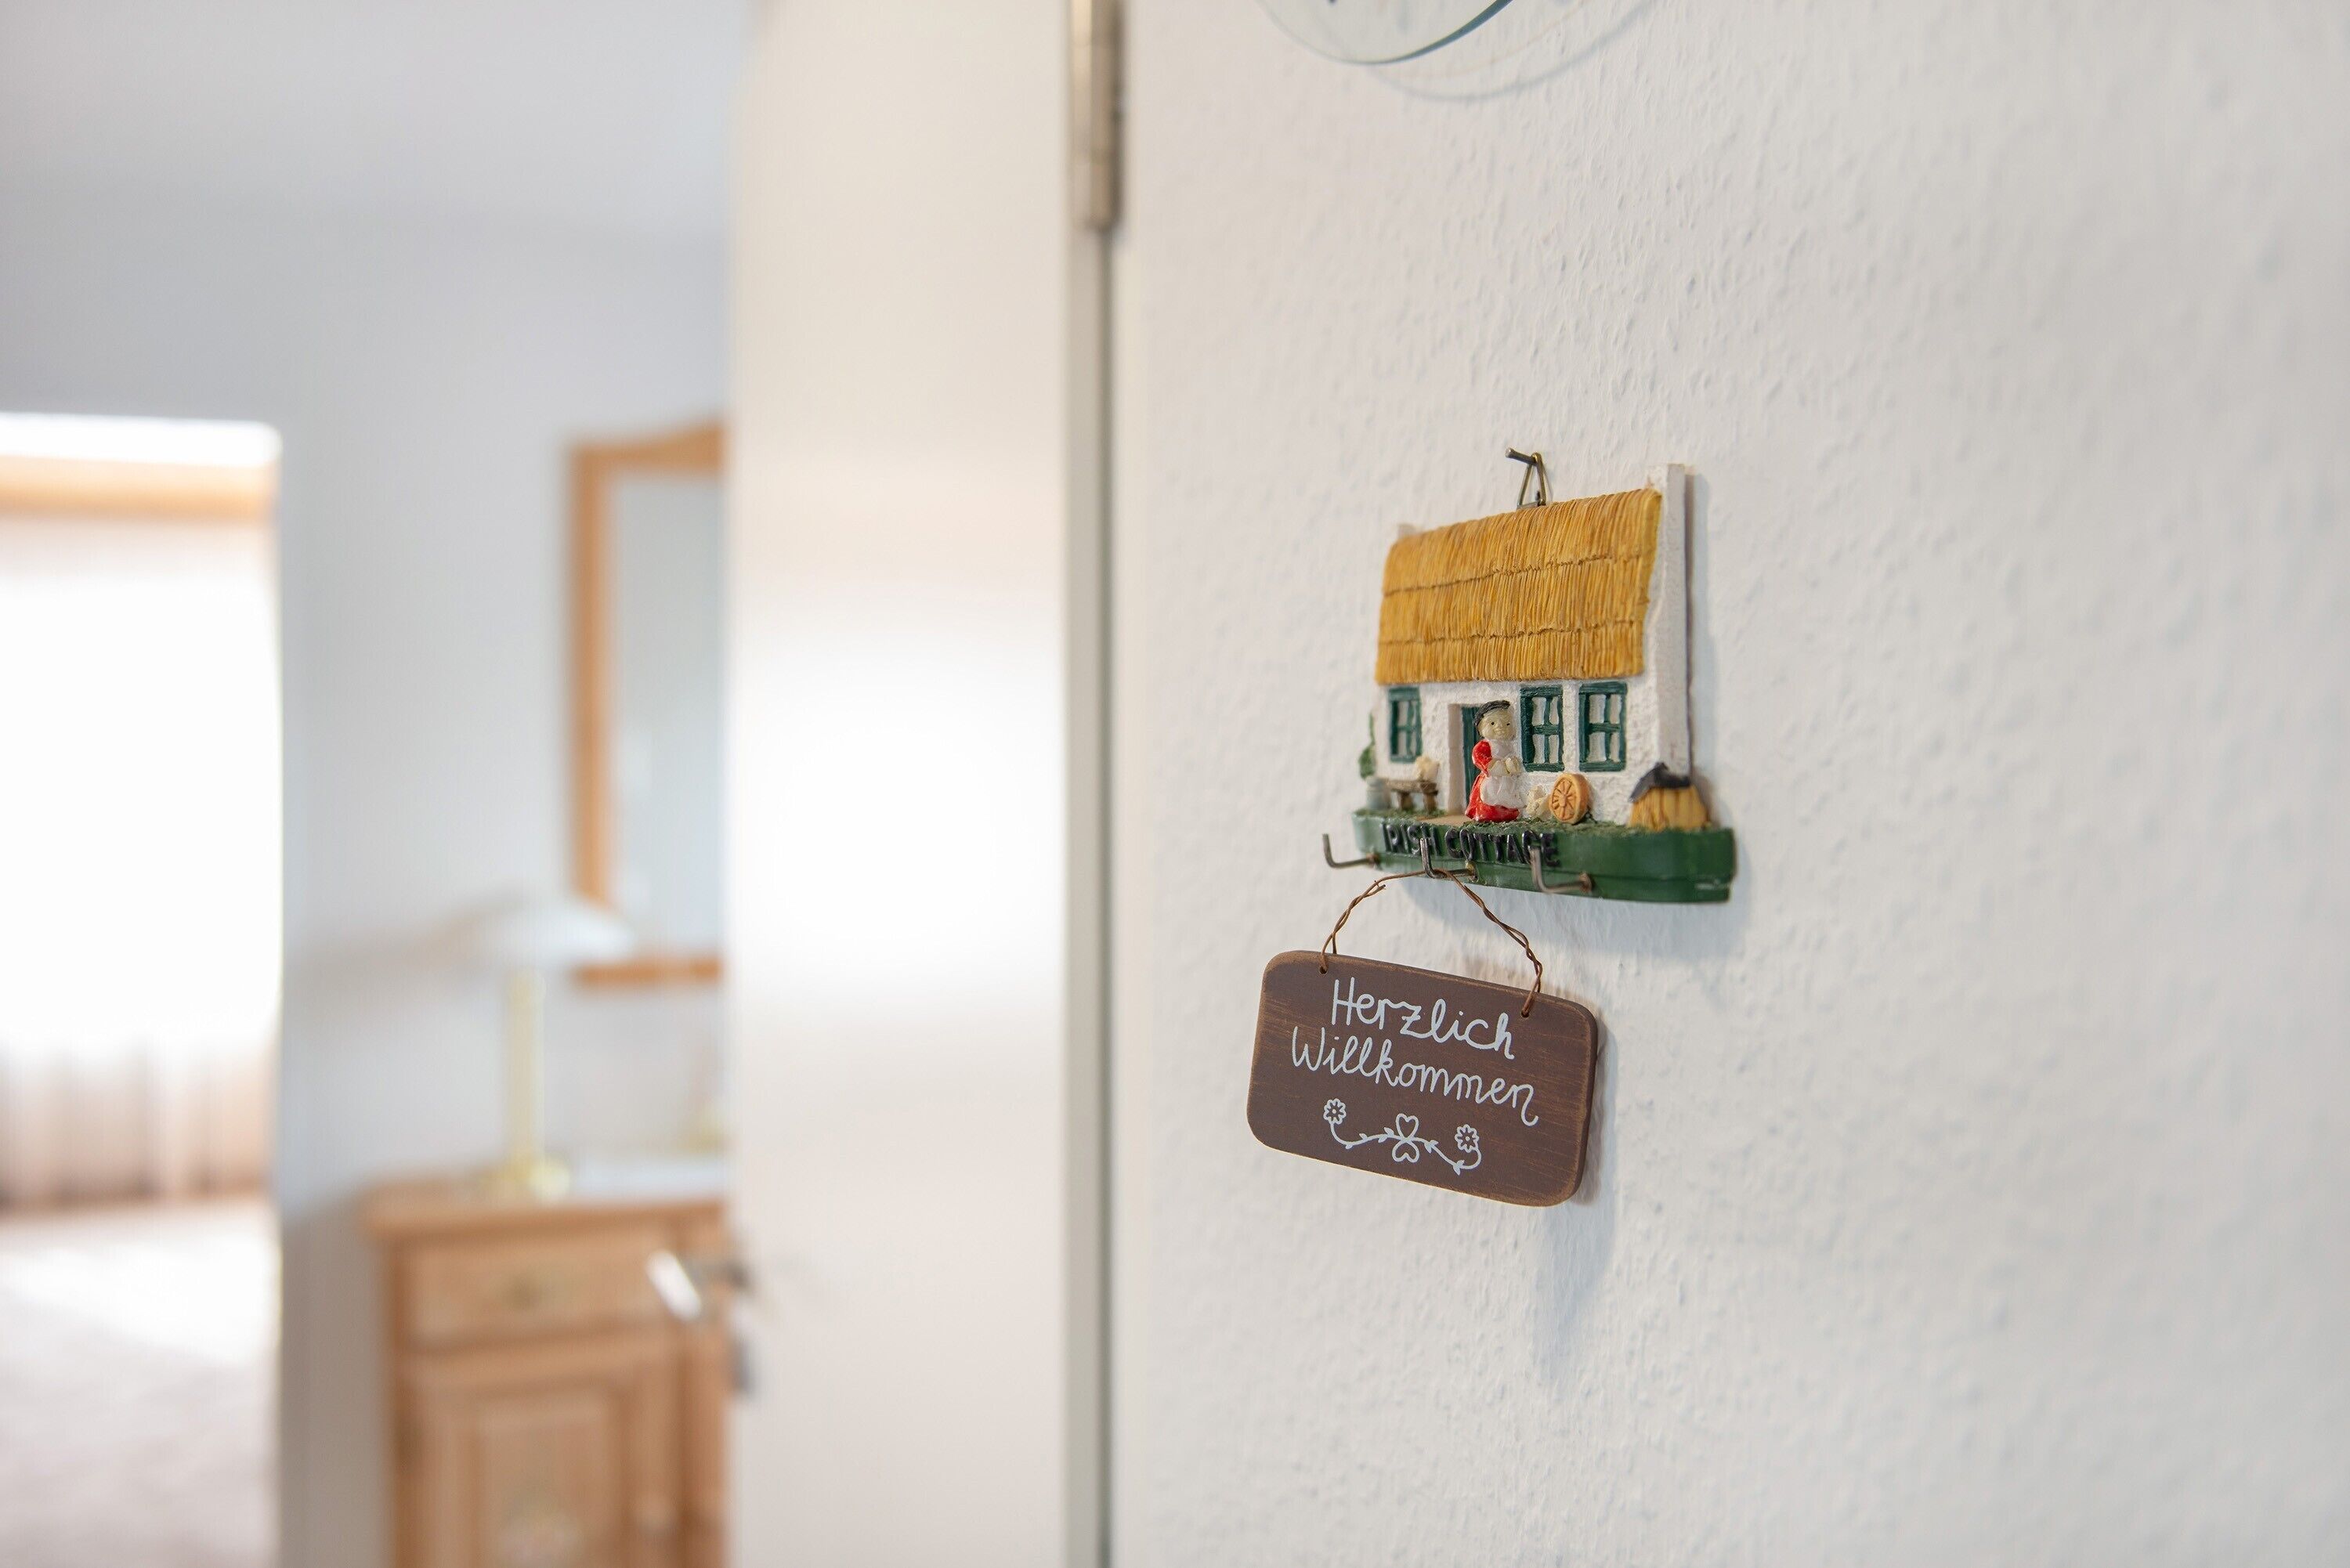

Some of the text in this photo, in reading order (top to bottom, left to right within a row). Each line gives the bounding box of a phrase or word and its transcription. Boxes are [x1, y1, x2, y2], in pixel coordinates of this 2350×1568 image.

[1380, 823, 1441, 856] IRISH
[1332, 977, 1515, 1060] Herzlich
[1292, 1025, 1539, 1126] Willkommen
